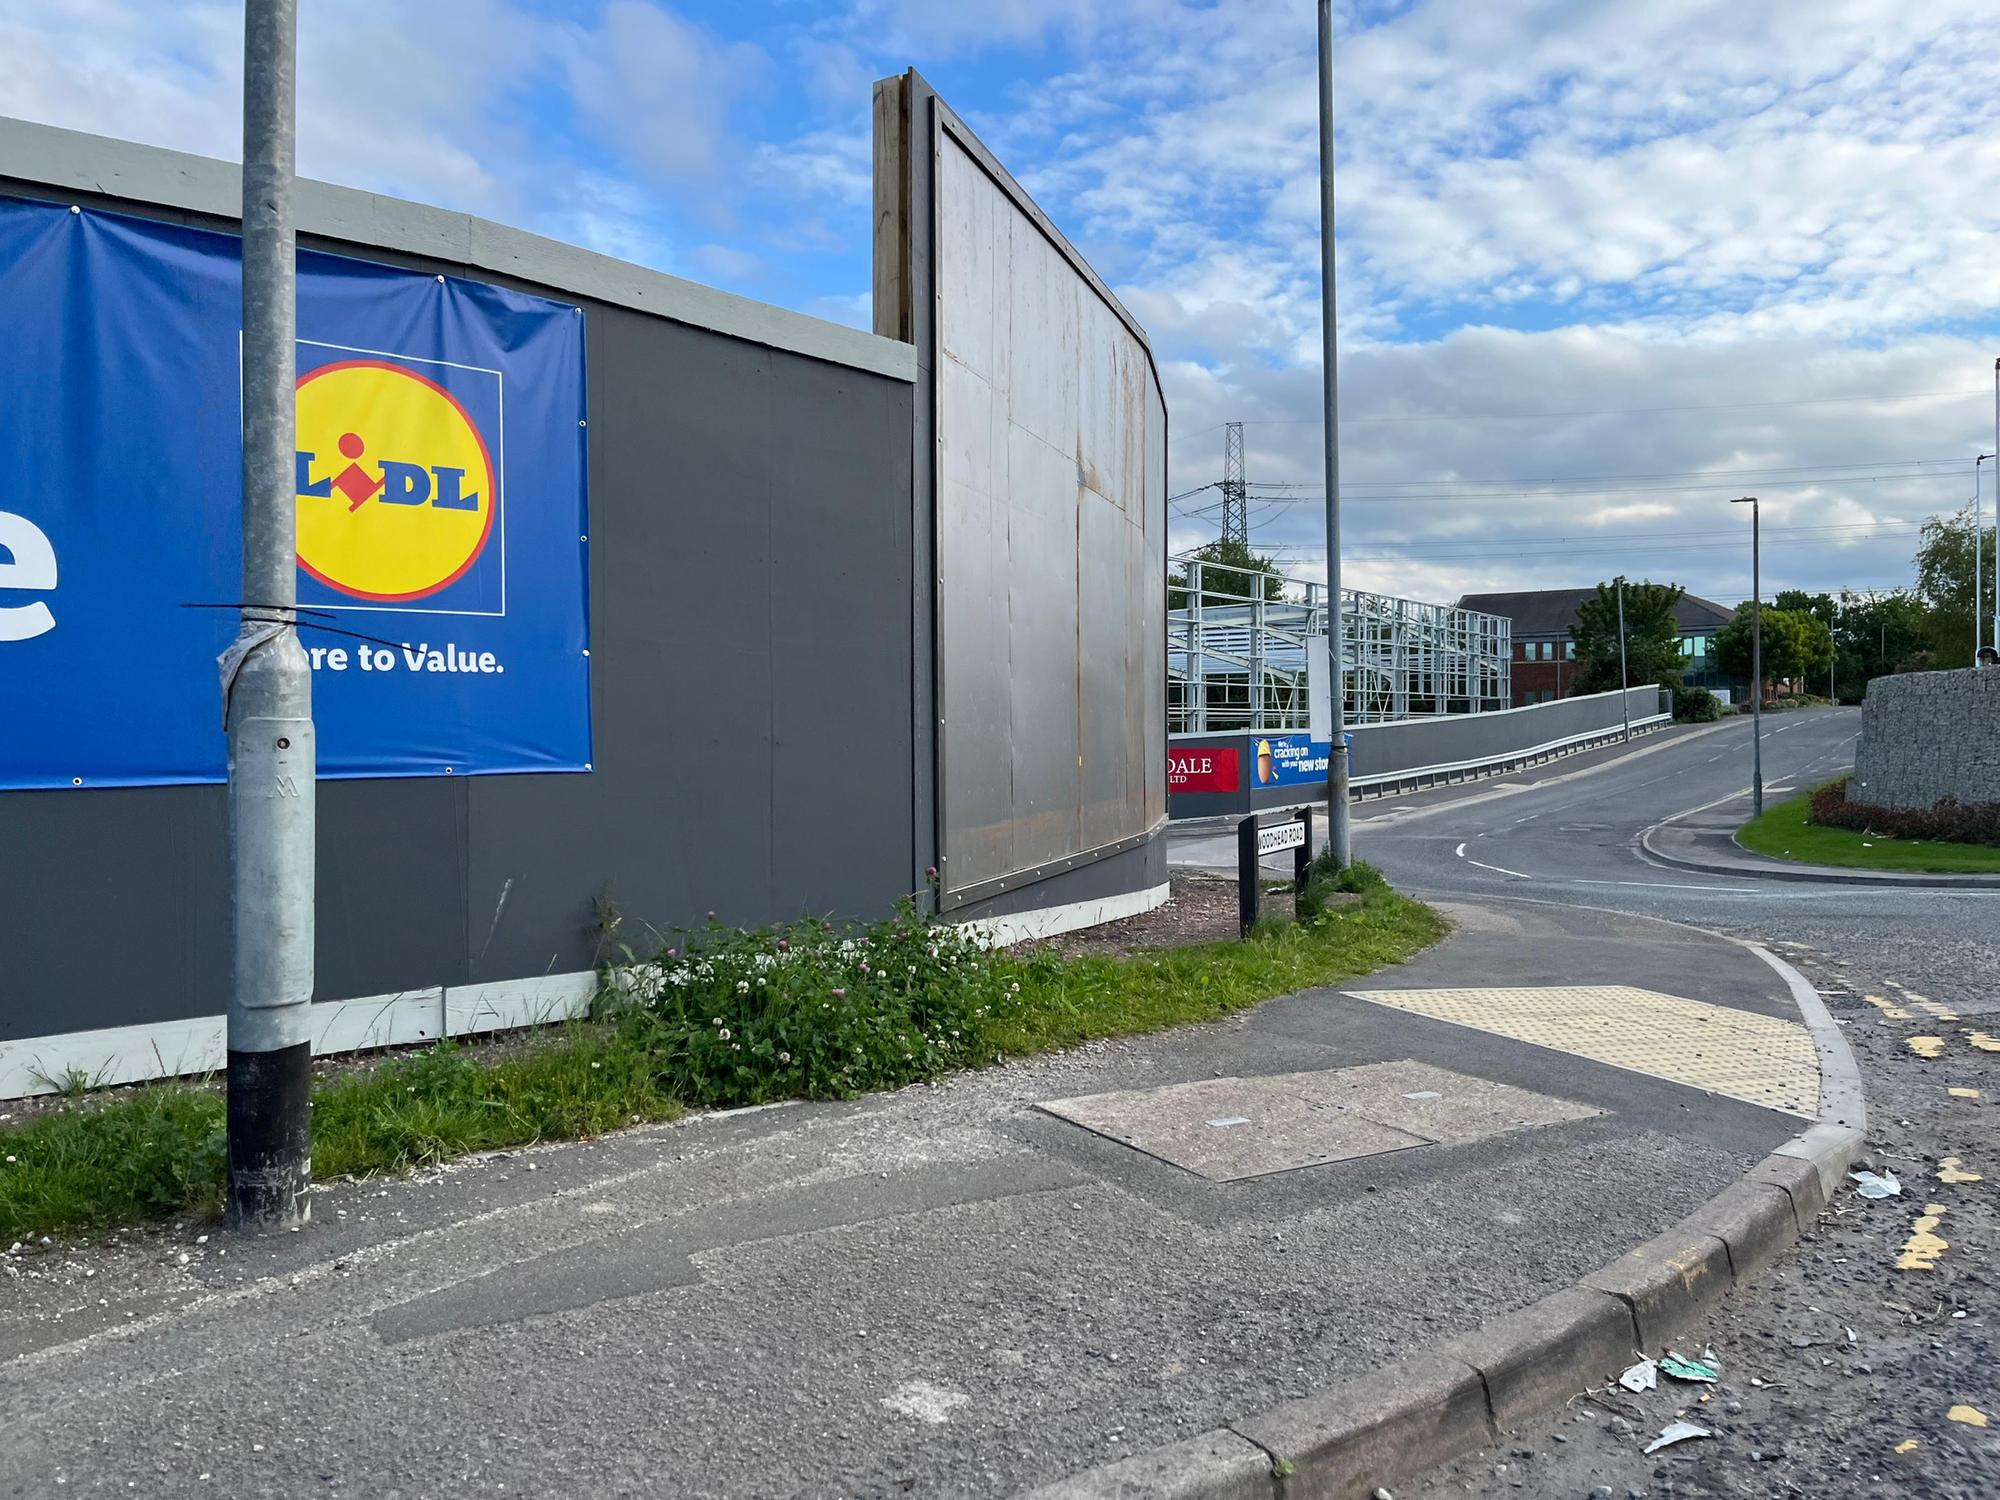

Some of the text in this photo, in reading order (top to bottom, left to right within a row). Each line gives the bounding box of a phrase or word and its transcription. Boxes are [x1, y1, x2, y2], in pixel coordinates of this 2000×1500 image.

[296, 432, 478, 513] LIDL
[302, 642, 504, 674] re to Value.
[1273, 744, 1309, 761] cracking on
[1298, 758, 1314, 773] new
[1314, 756, 1329, 771] stor
[1169, 775, 1187, 784] LTD
[1289, 826, 1304, 843] ROAD
